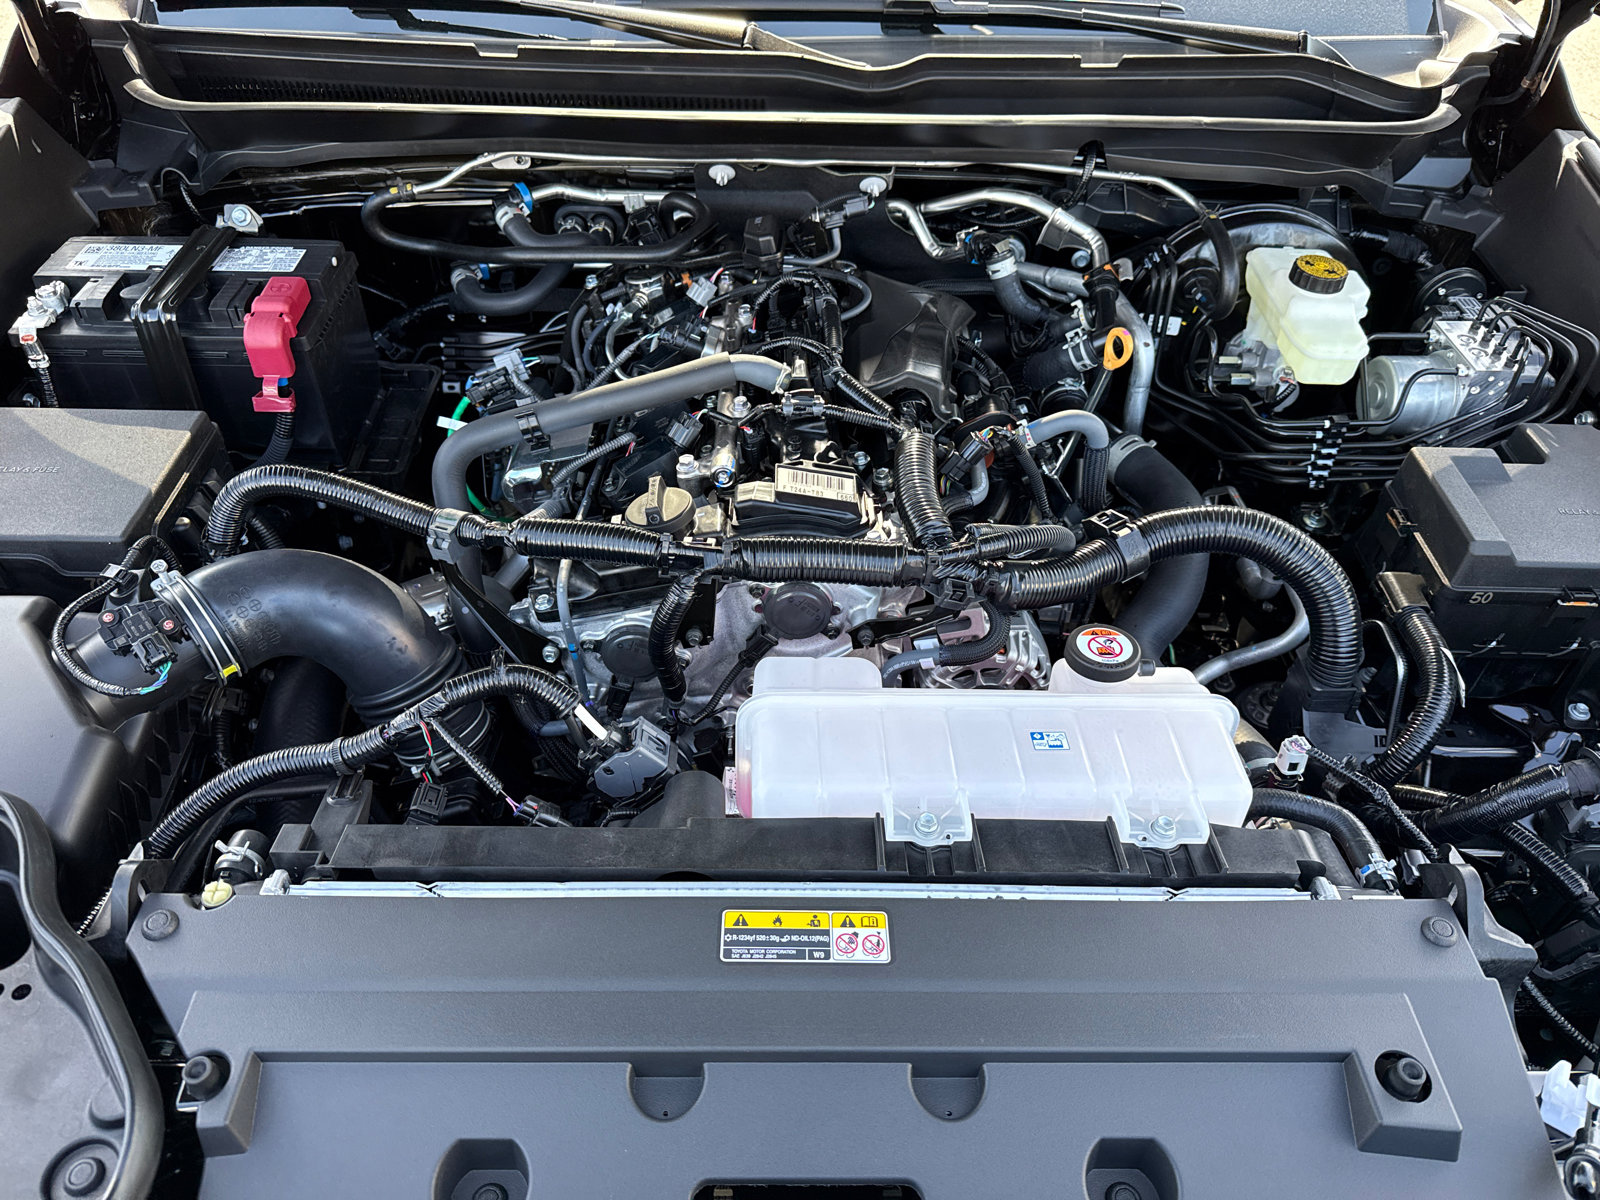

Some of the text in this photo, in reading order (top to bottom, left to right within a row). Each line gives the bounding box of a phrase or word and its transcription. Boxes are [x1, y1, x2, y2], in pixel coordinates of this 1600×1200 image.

[1468, 592, 1494, 604] 50
[732, 934, 756, 942] R-1234yf
[812, 951, 825, 959] W9
